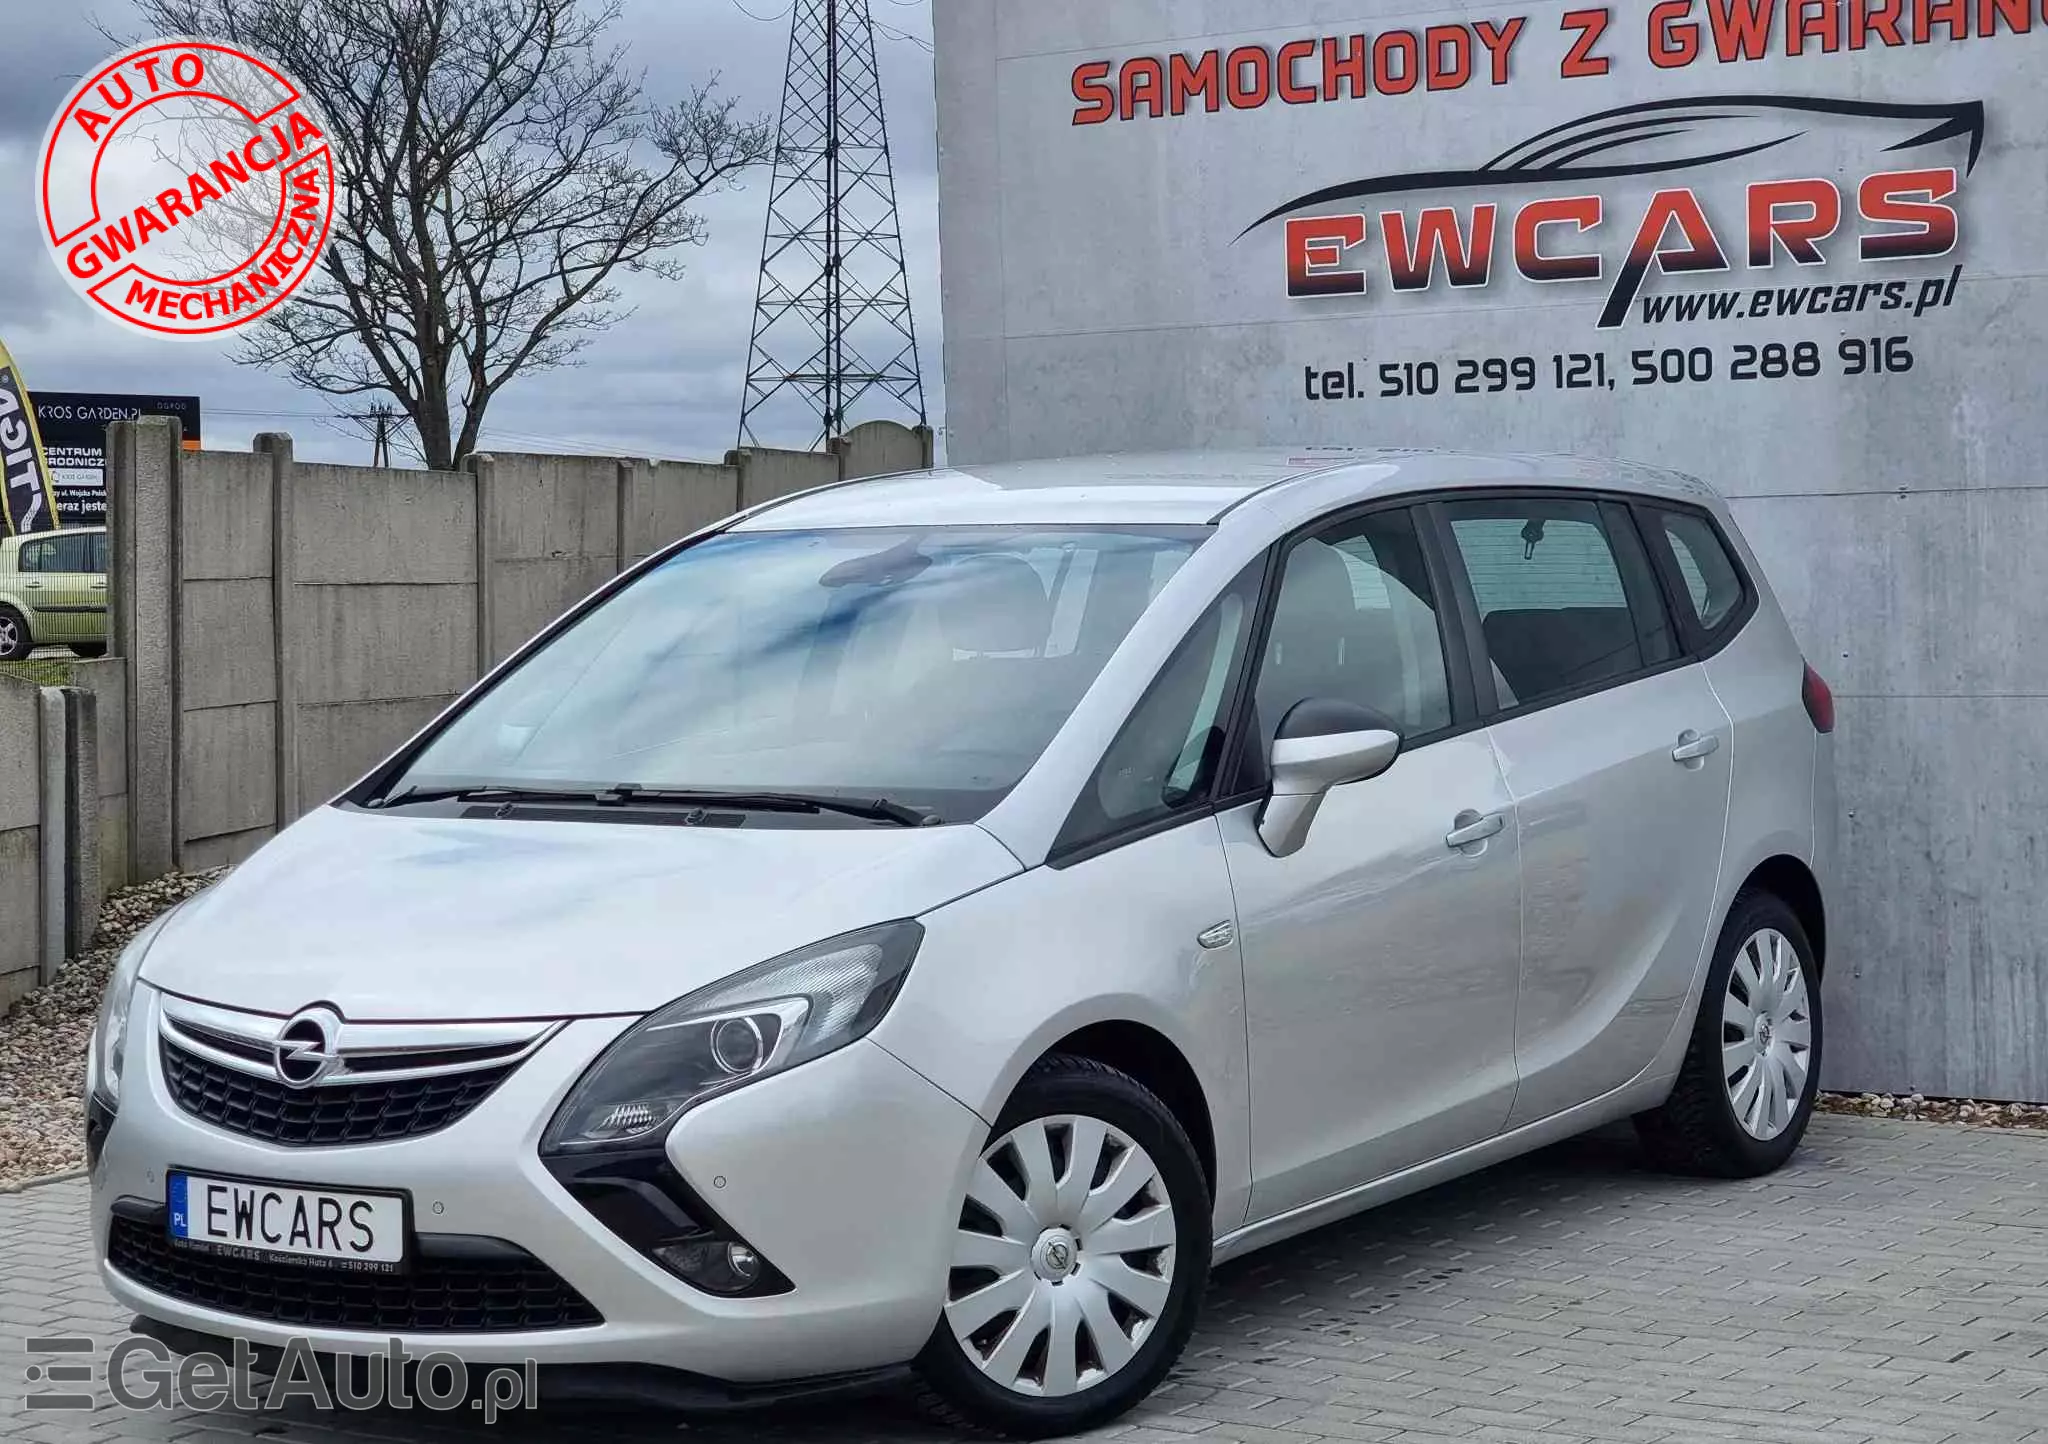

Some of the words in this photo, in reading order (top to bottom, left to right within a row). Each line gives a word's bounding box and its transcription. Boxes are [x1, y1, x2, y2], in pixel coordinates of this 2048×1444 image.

[1071, 16, 1527, 126] SAMOCHODY
[1560, 8, 1610, 79] Z
[1647, 0, 2048, 69] GWARAN
[1285, 167, 1958, 329] EWCARS
[1642, 264, 1963, 318] www.ewcars.pl
[1304, 361, 1364, 400] tel.
[1379, 361, 1439, 397] 510
[1454, 356, 1536, 393] 299
[1552, 352, 1615, 391] 121,
[1631, 347, 1713, 385] 500
[1730, 341, 1821, 380] 288
[1837, 336, 1914, 375] 916
[38, 405, 72, 419] KROS
[56, 502, 80, 511] eraz
[174, 1212, 188, 1227] PL
[206, 1184, 374, 1252] EWCARS
